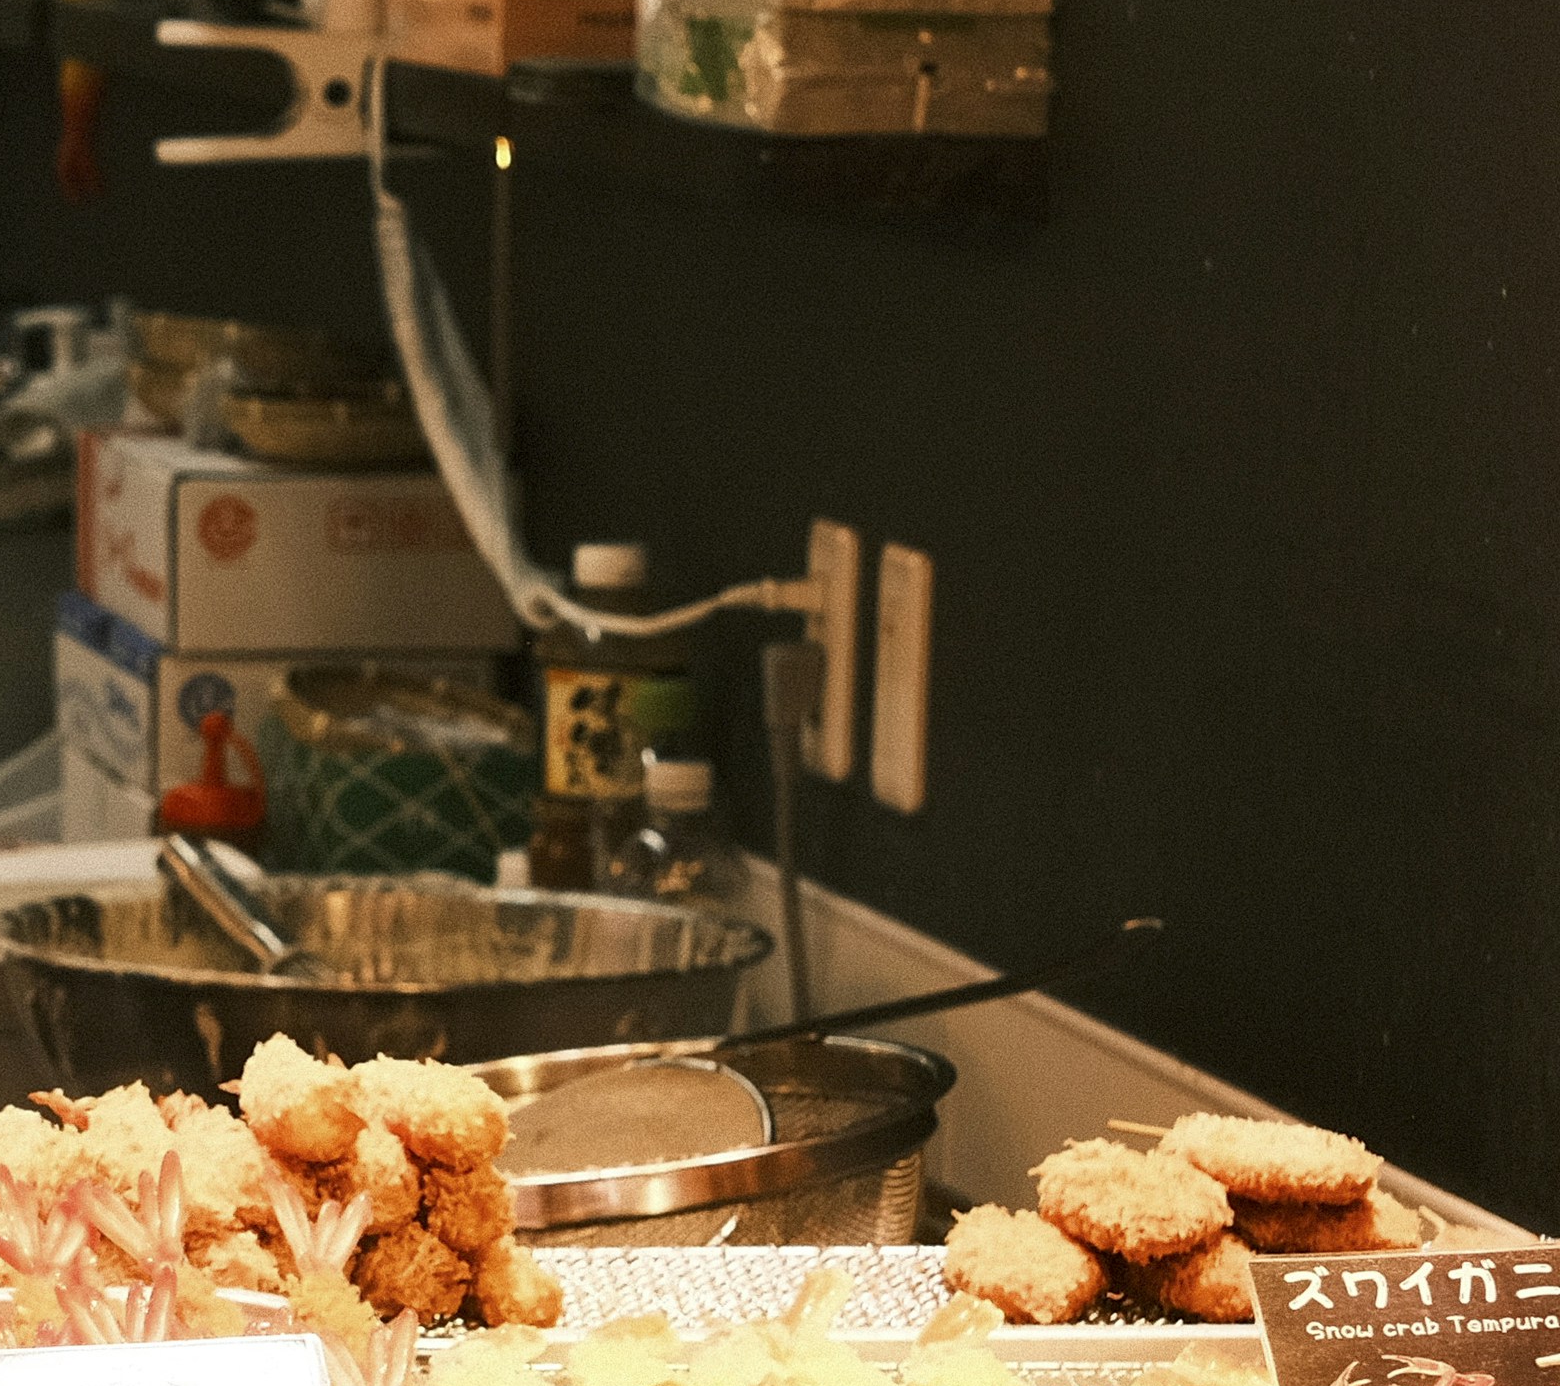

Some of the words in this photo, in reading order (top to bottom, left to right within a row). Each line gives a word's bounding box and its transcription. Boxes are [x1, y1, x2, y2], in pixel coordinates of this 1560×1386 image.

[1283, 1258, 1560, 1310] ズワイガニ
[1306, 1320, 1374, 1341] Snow
[1383, 1315, 1440, 1337] crab
[1446, 1313, 1560, 1334] Tempura
